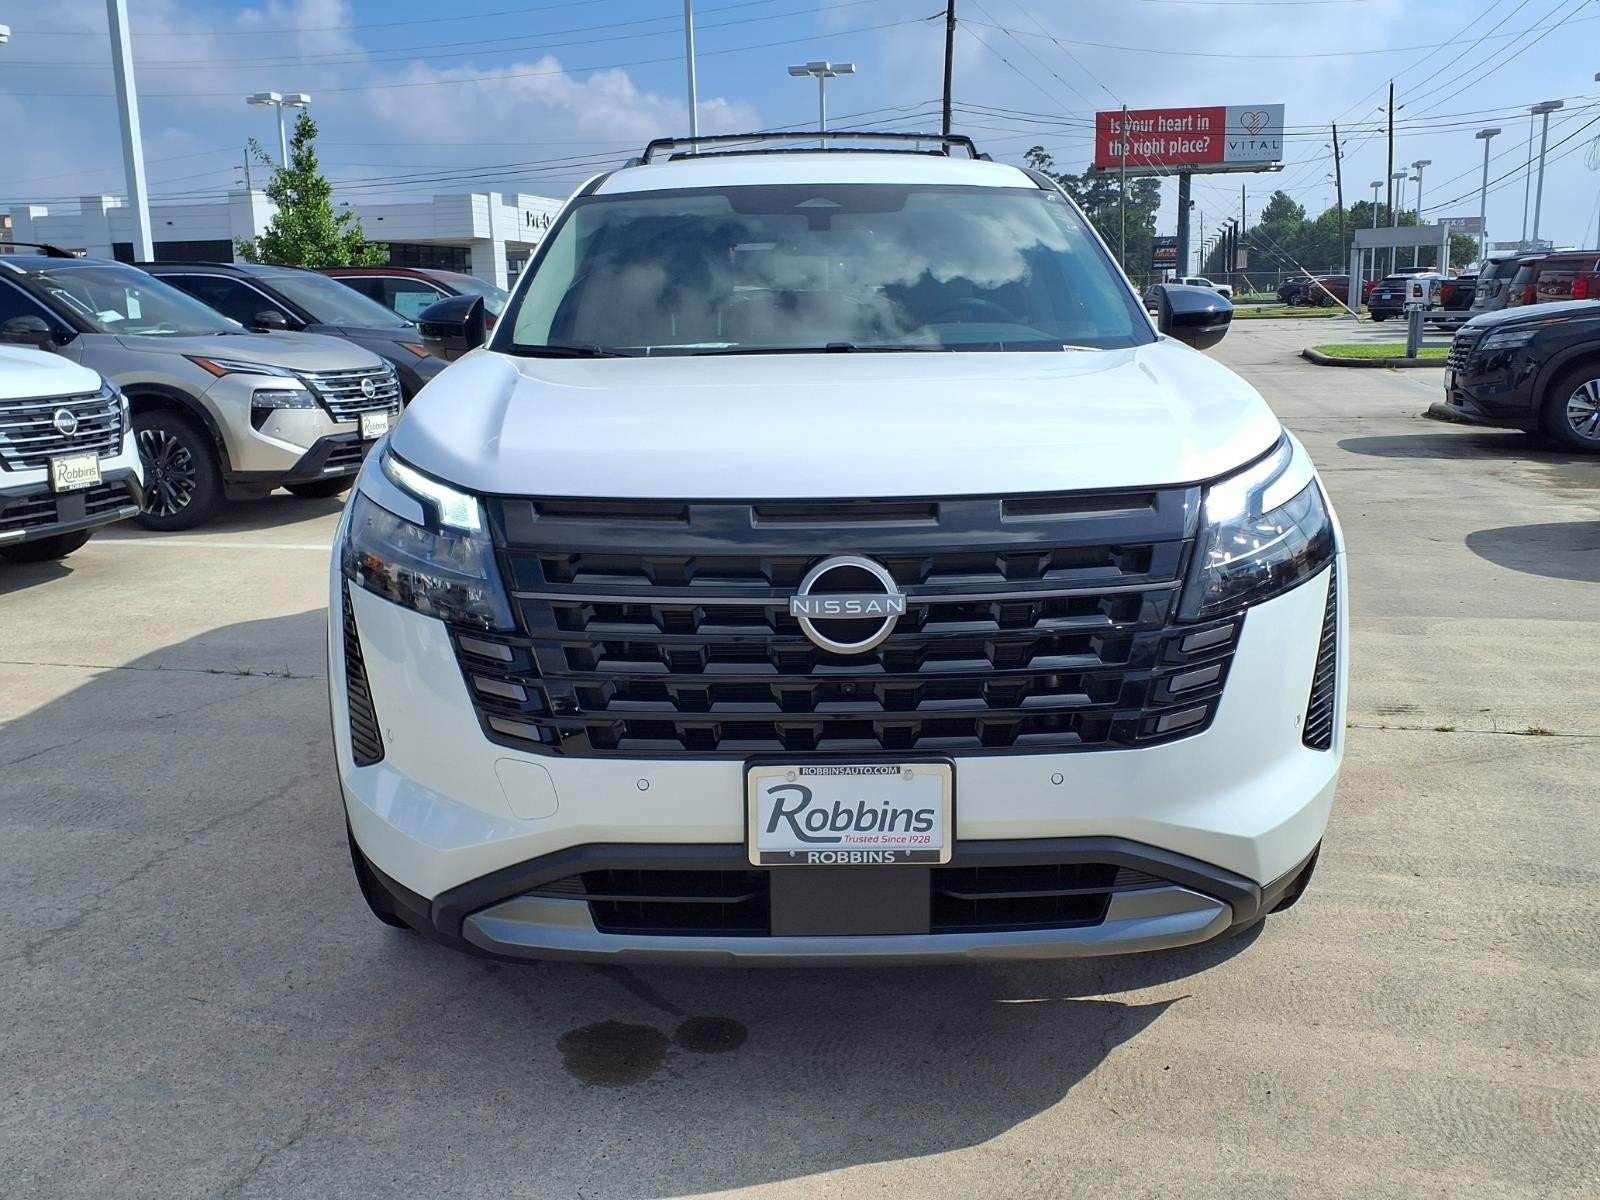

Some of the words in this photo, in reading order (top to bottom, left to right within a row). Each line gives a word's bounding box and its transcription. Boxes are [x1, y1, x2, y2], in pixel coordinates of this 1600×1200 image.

[1110, 117, 1121, 134] Is
[1124, 119, 1155, 136] your
[1158, 115, 1193, 132] heart
[1197, 113, 1210, 130] in
[1108, 139, 1130, 156] the
[1133, 137, 1166, 157] right
[1169, 136, 1210, 156] place?
[1229, 139, 1280, 150] VITAL
[57, 463, 97, 483] Robbins
[793, 598, 903, 614] NISSAN
[802, 766, 898, 776] ROBBINSAUTO.COM
[766, 783, 935, 844] Robbins
[845, 834, 879, 844] Trusted
[881, 834, 907, 844] Since
[909, 834, 931, 844] 1928
[807, 850, 896, 864] ROBBINS
